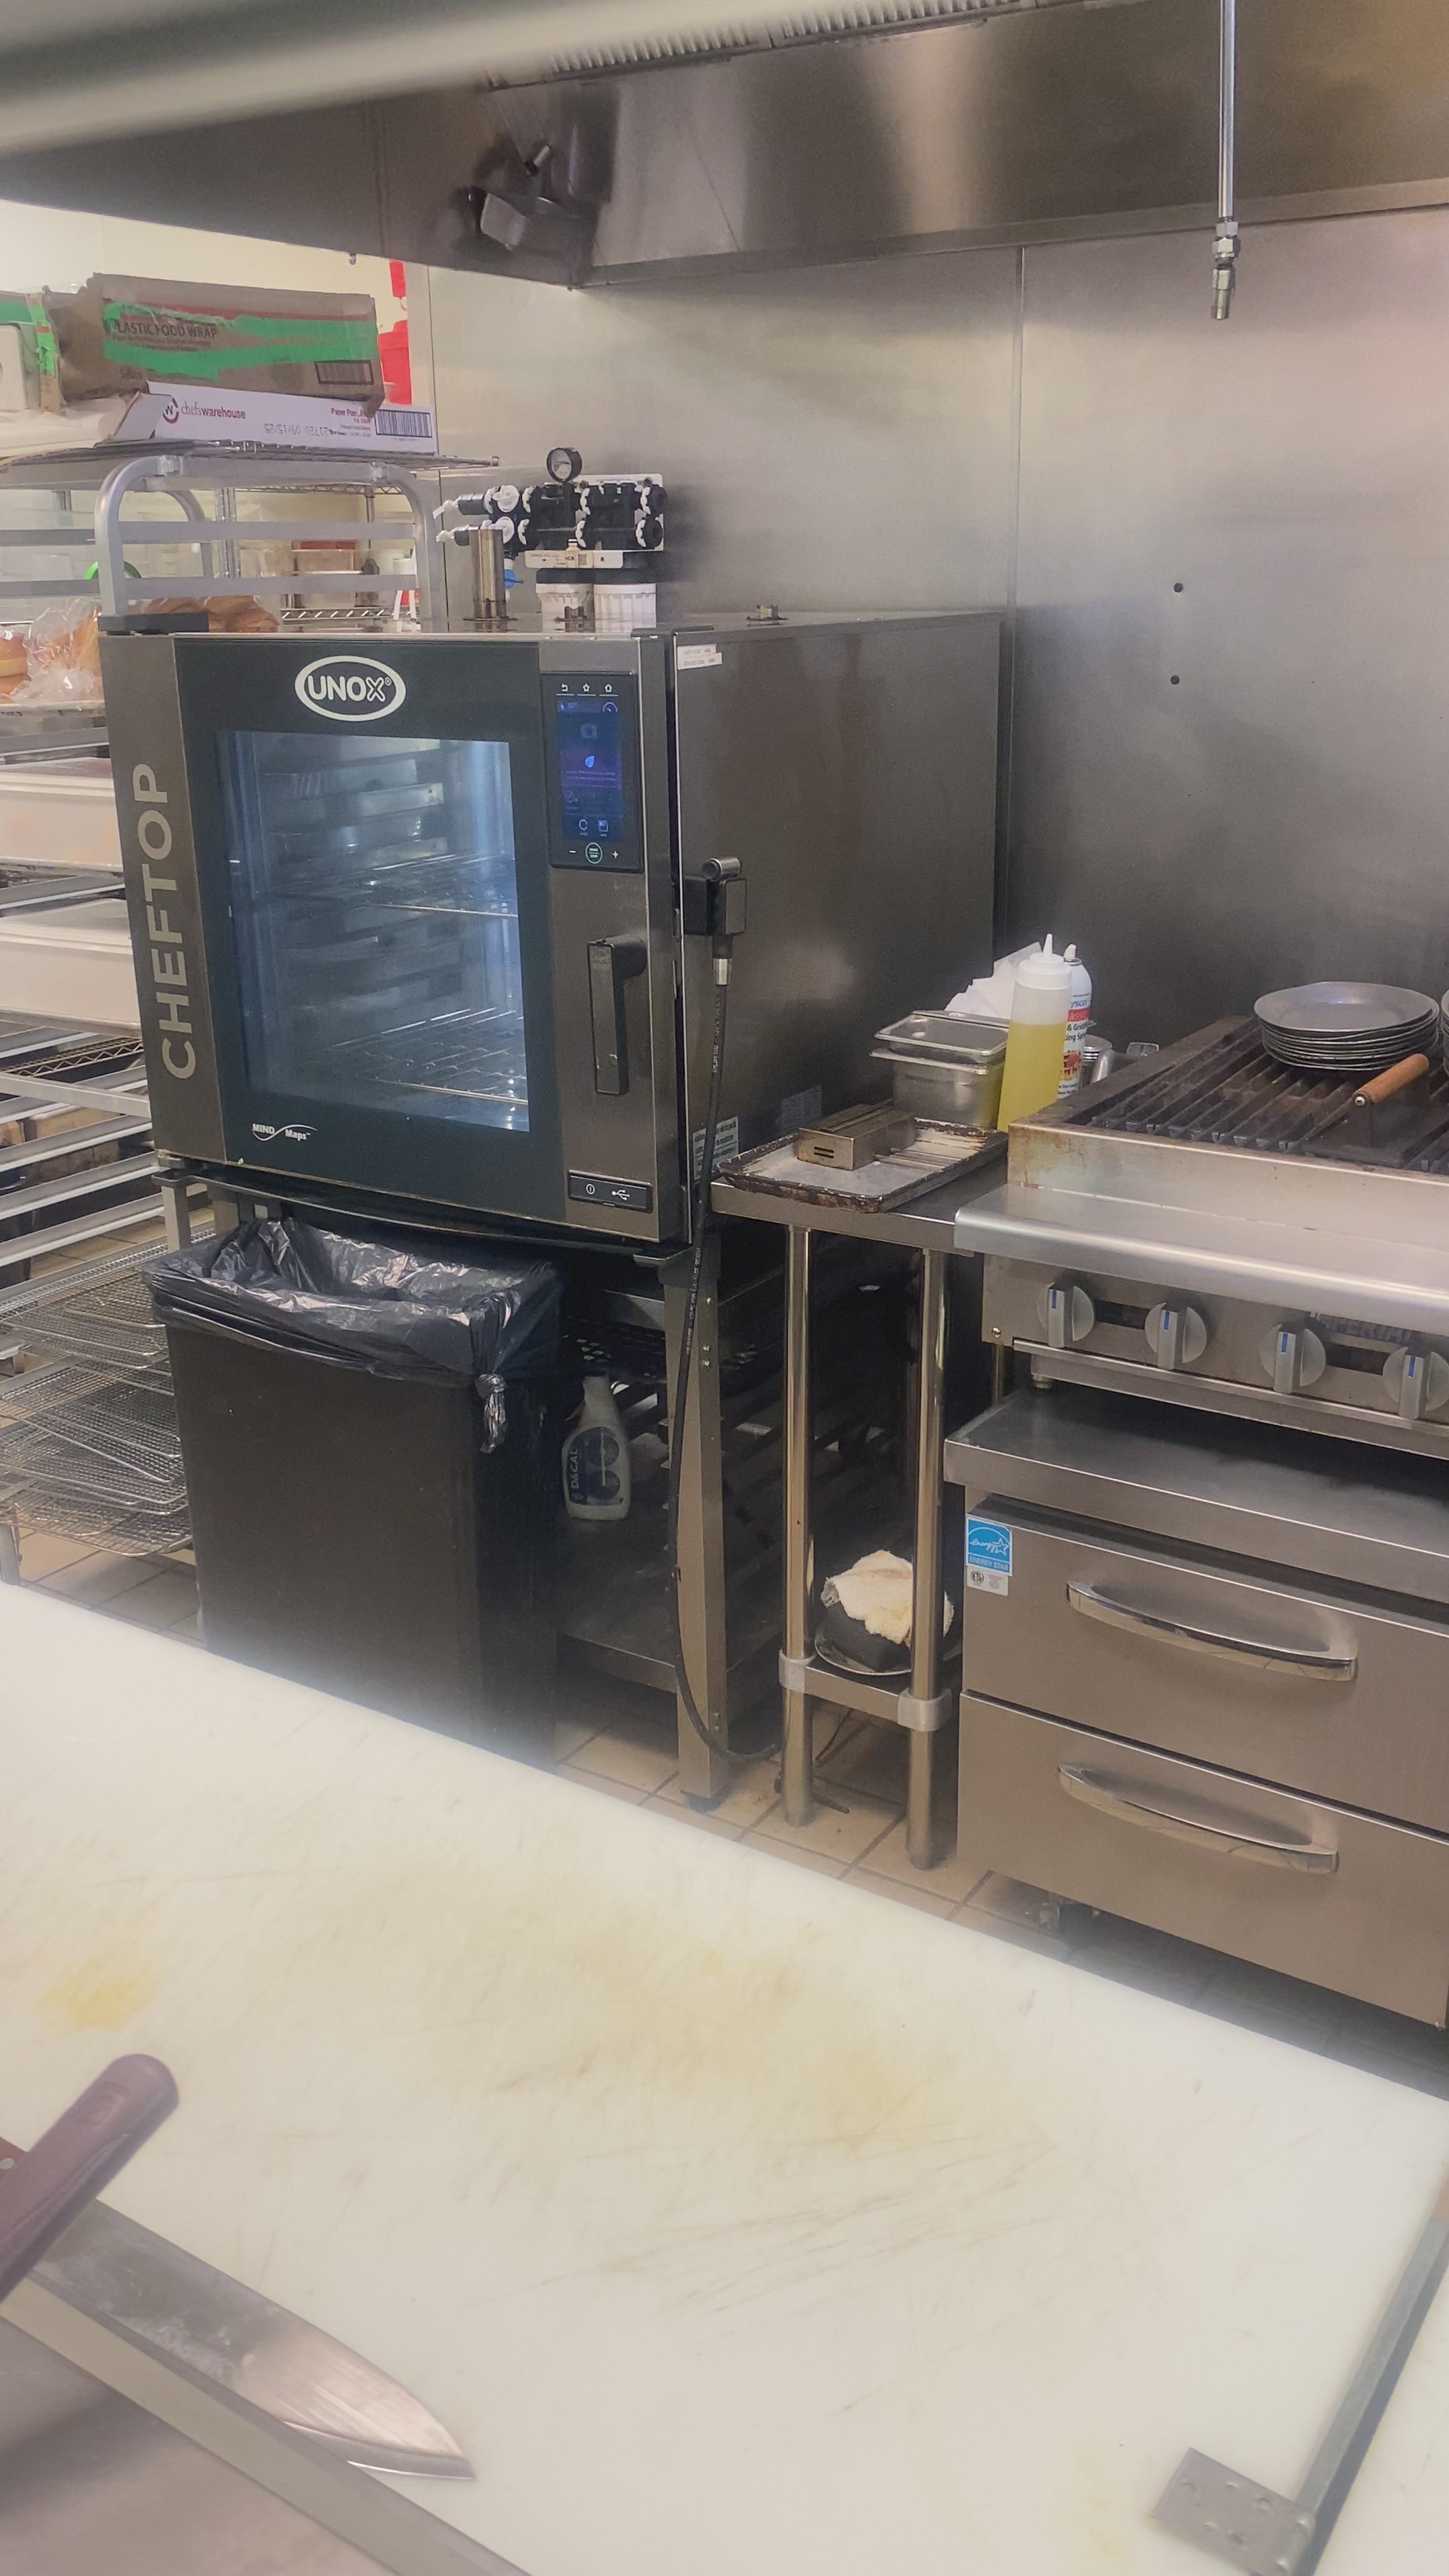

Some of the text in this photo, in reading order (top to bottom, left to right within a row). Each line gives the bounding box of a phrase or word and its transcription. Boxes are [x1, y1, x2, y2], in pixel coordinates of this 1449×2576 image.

[186, 326, 217, 339] WRAP
[180, 400, 246, 419] chefswarehouse
[133, 763, 196, 1079] CHEFTOP
[252, 1123, 276, 1135] MIND
[969, 1556, 1009, 1572] ENERGY STAR
